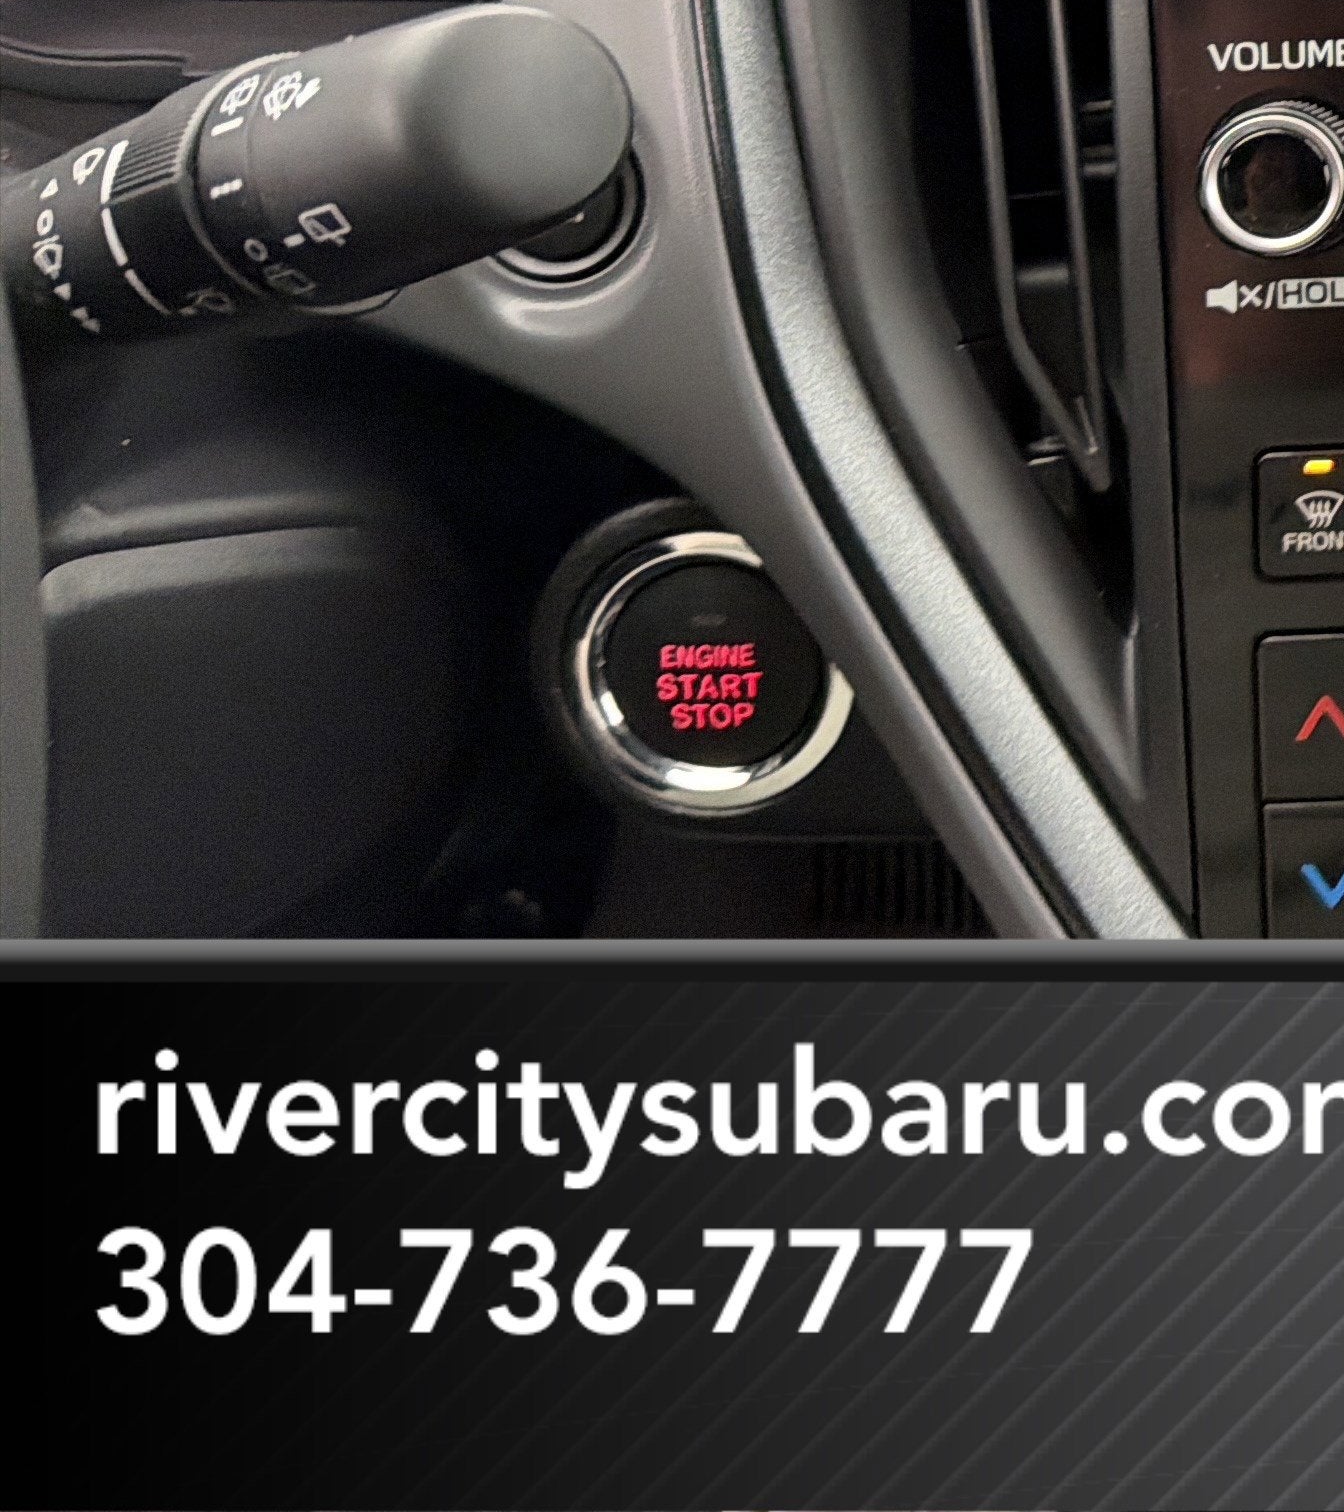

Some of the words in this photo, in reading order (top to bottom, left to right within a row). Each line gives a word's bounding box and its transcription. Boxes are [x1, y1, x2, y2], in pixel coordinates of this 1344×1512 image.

[659, 643, 756, 670] ENGINE
[656, 671, 763, 701] START
[670, 702, 755, 730] STOP
